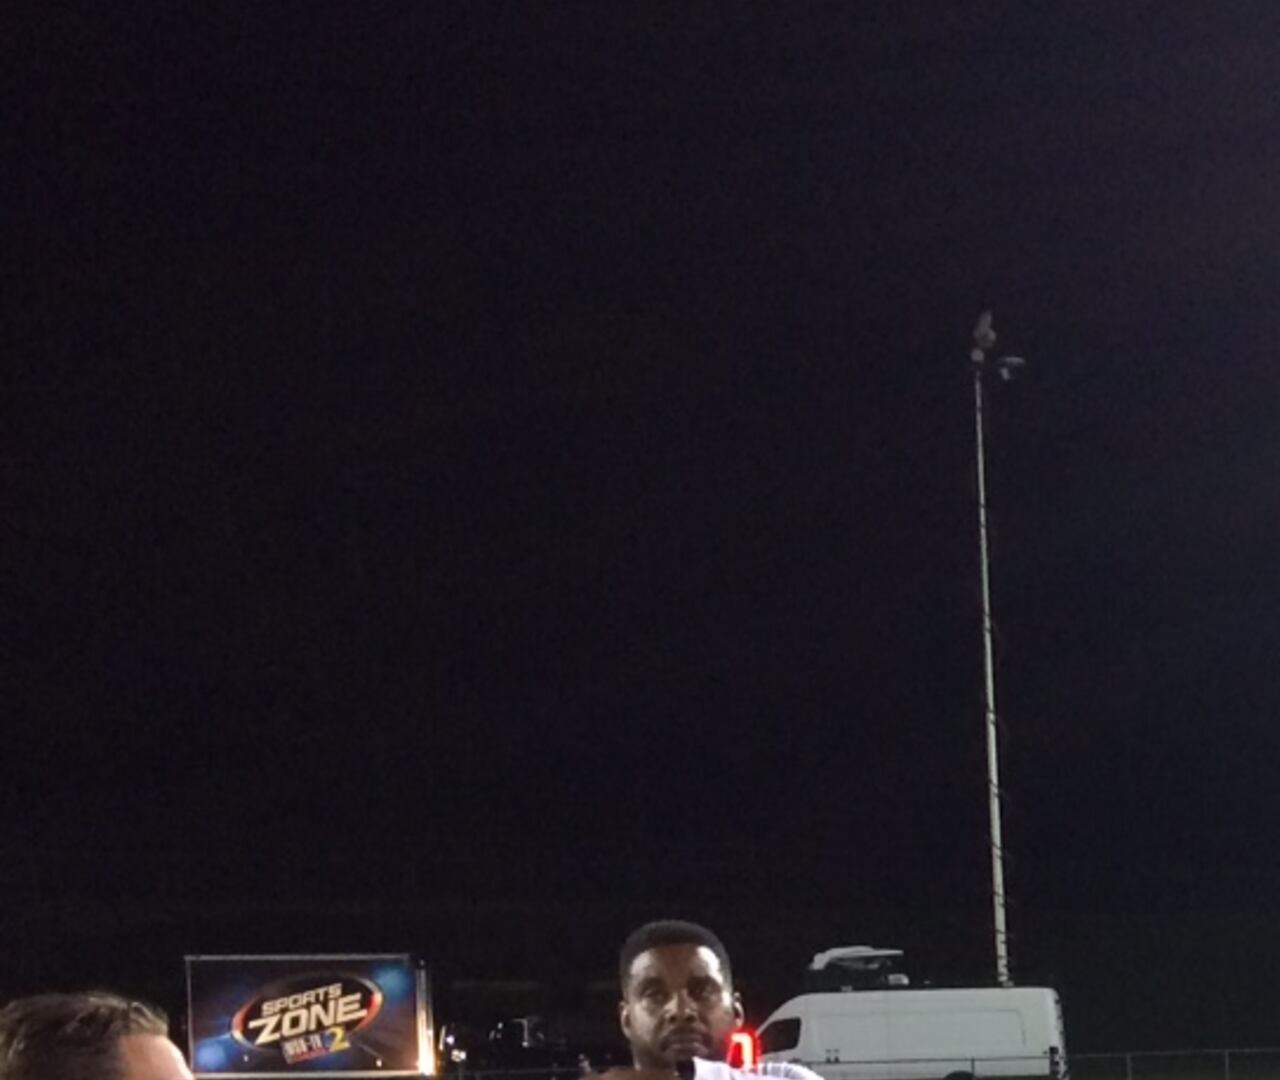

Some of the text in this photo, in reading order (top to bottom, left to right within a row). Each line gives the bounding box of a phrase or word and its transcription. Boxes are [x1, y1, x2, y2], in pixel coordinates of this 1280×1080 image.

[262, 983, 343, 1017] SPORTS
[249, 993, 368, 1046] ZONE
[326, 1025, 351, 1052] 2
